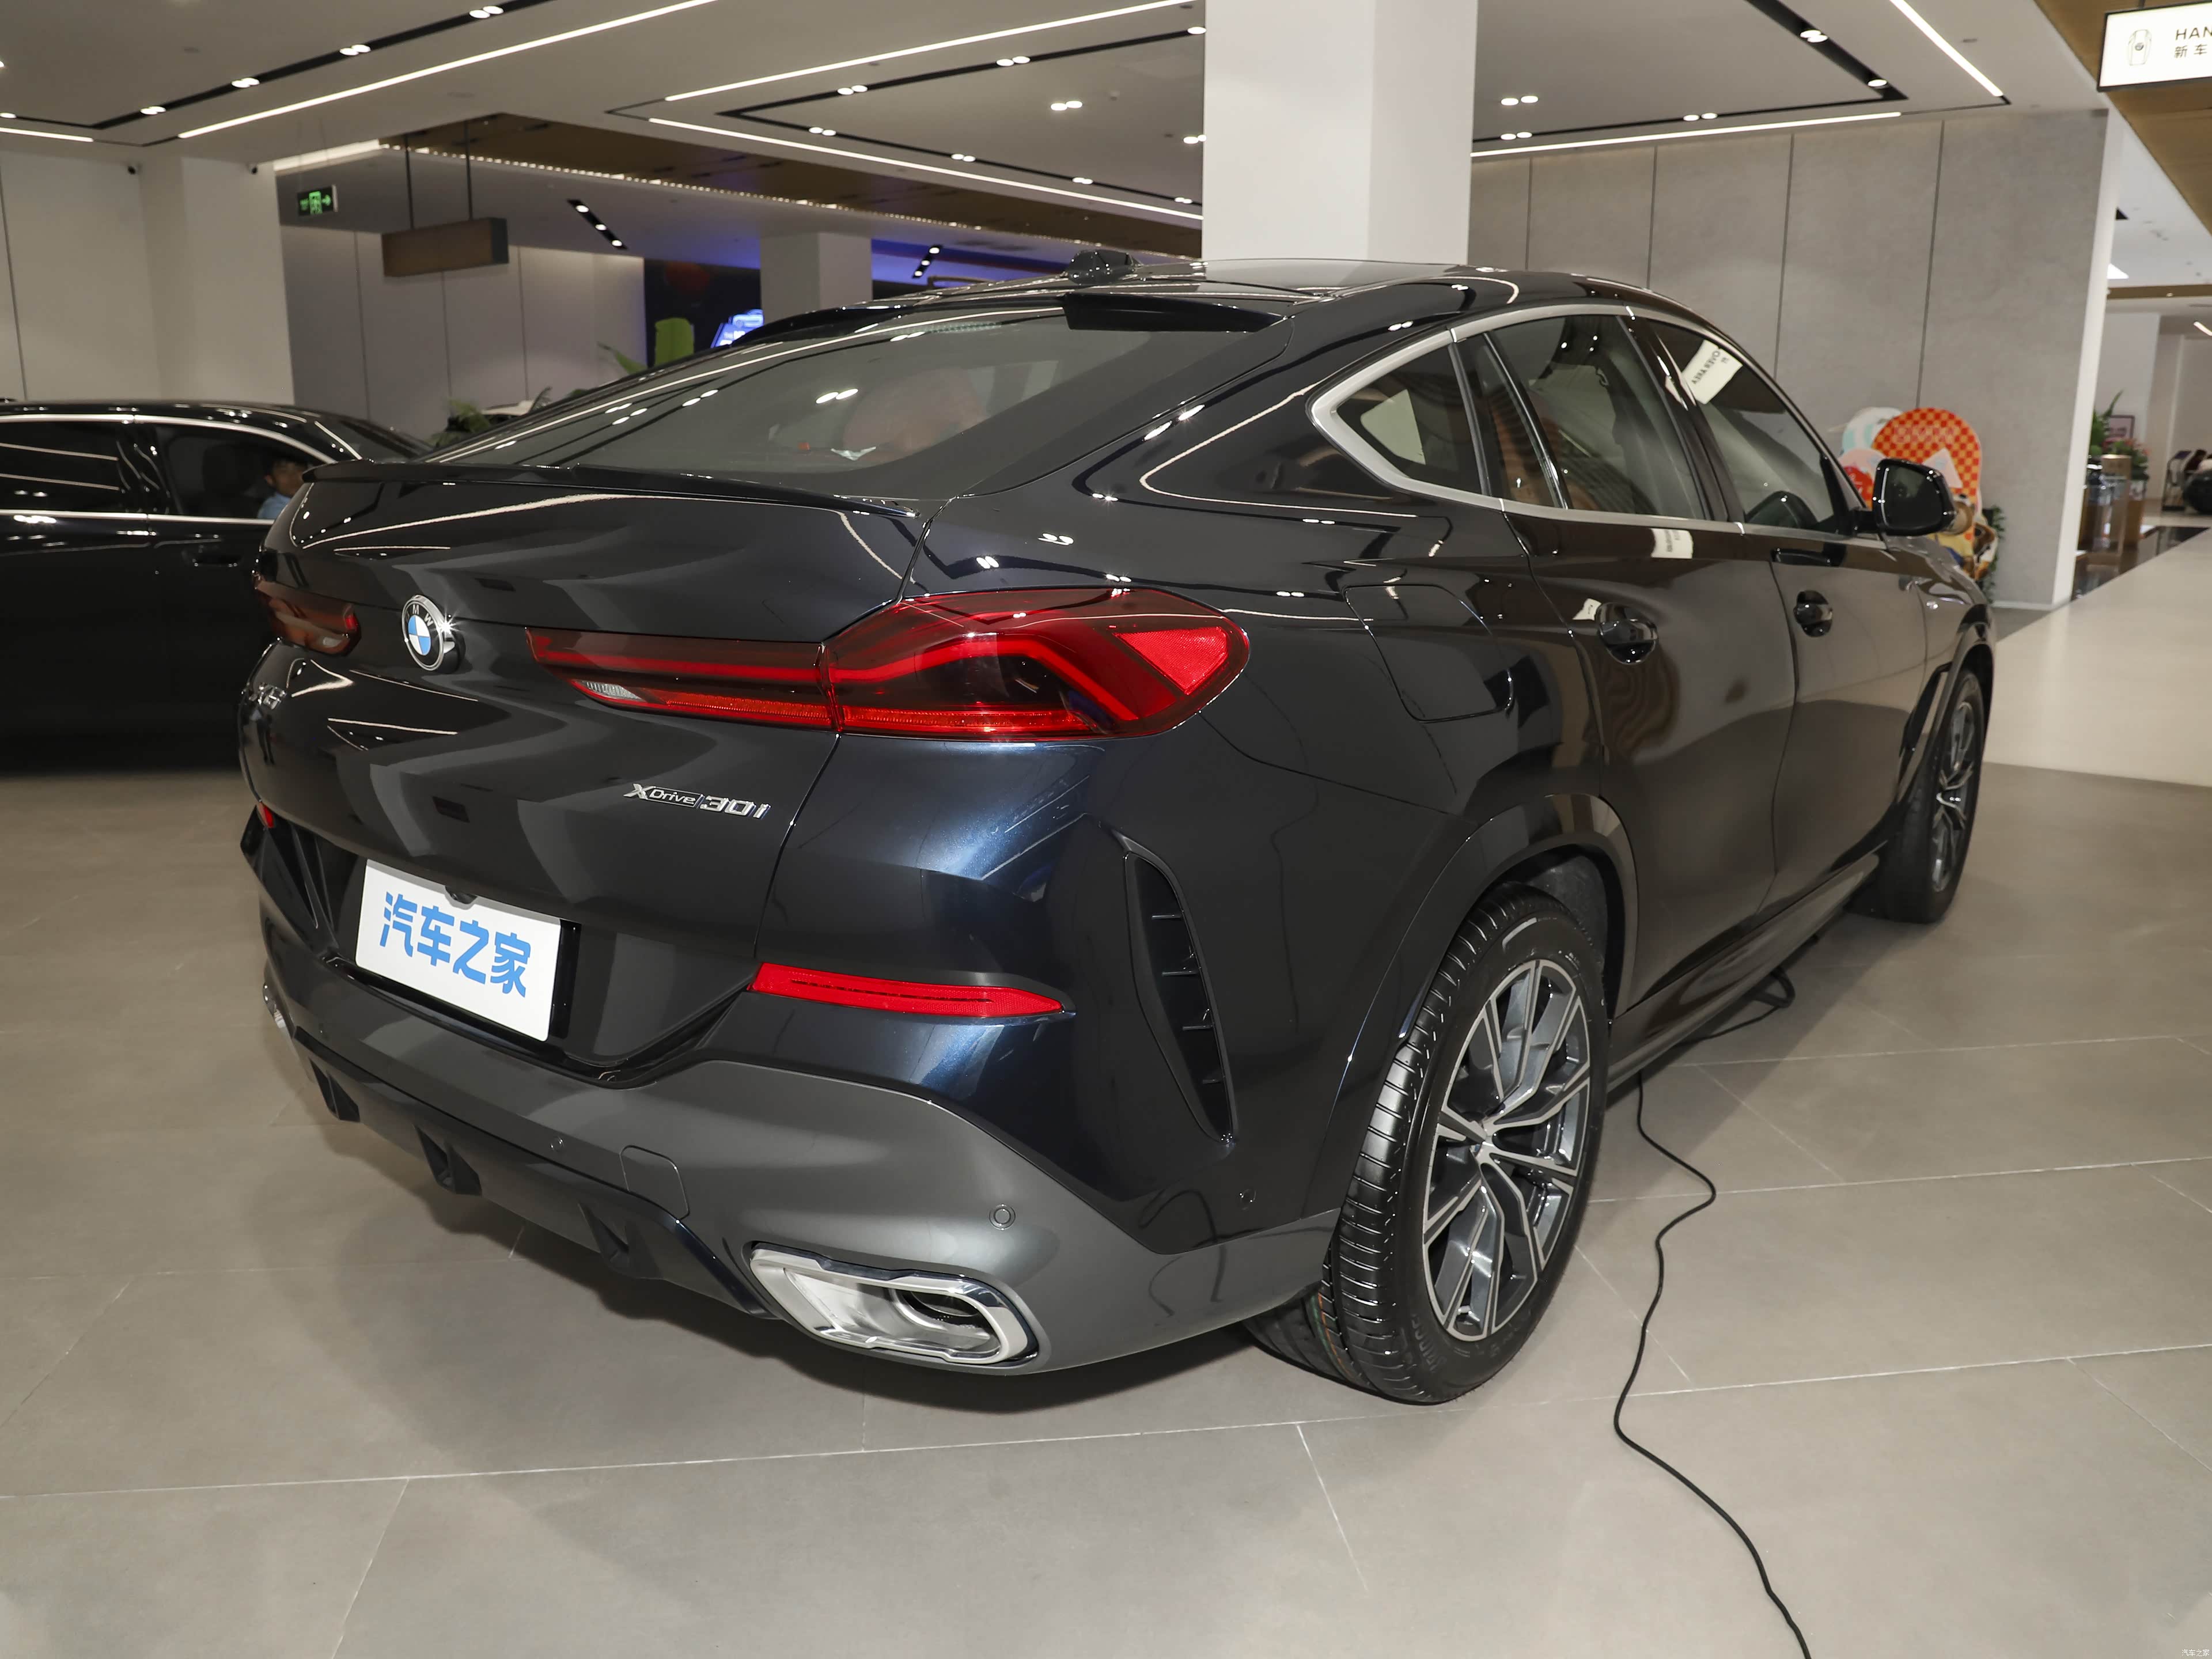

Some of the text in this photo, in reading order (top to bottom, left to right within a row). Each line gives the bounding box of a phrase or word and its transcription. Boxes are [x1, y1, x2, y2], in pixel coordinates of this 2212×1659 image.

[2175, 26, 2212, 40] HAN
[2174, 44, 2207, 58] 新车
[380, 891, 531, 998] 汽车之家
